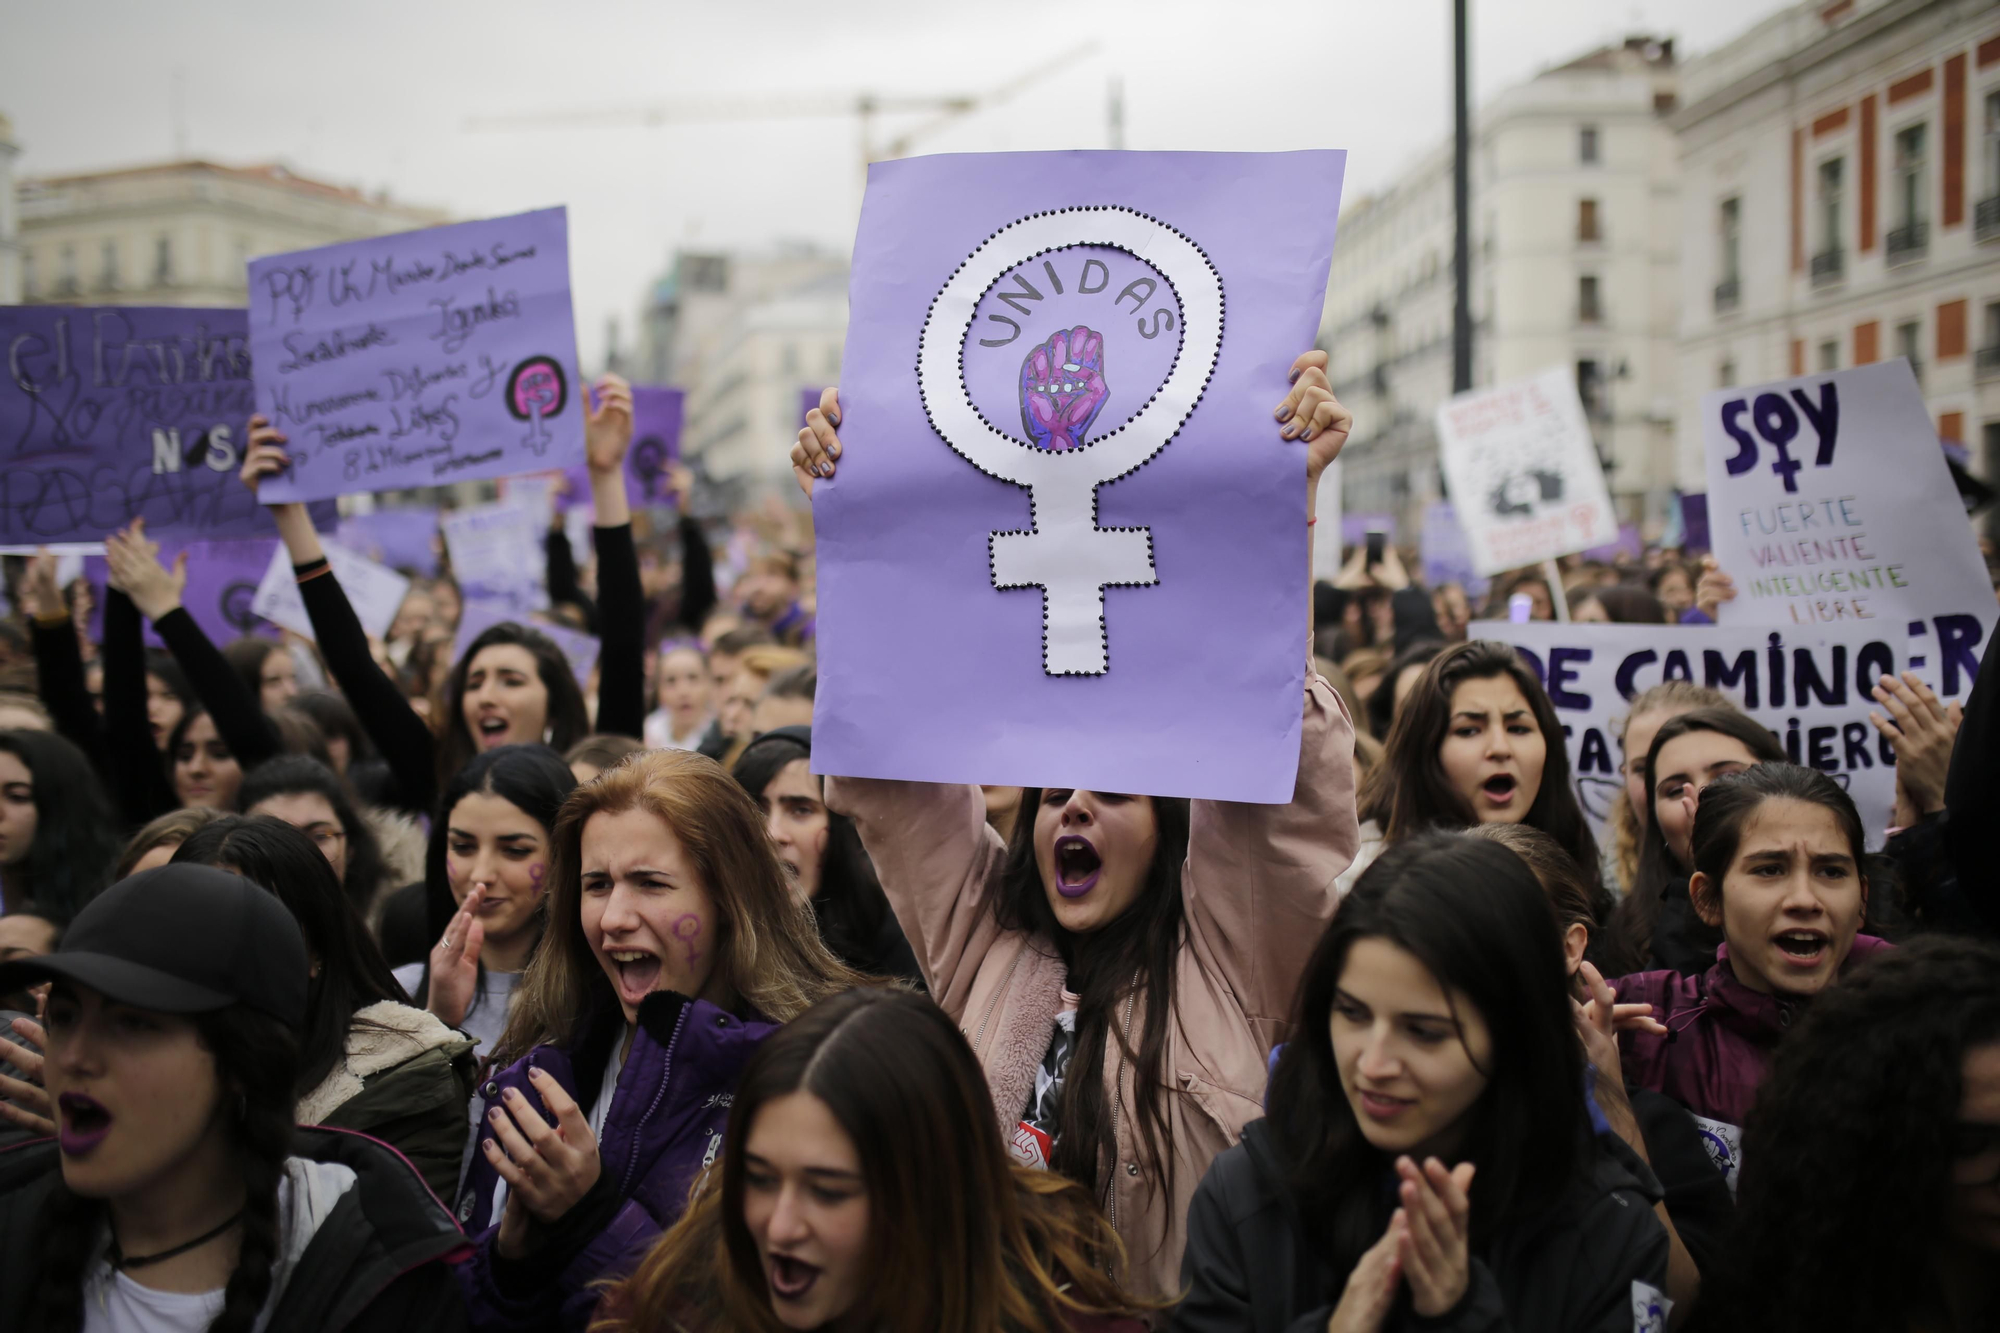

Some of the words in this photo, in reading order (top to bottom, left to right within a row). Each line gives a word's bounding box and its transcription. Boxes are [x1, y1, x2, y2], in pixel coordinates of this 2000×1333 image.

[978, 259, 1175, 348] UNIDAS
[1721, 381, 1839, 493] SOY
[1740, 495, 1863, 536] FUERTE
[1750, 532, 1876, 568] VALIENTE
